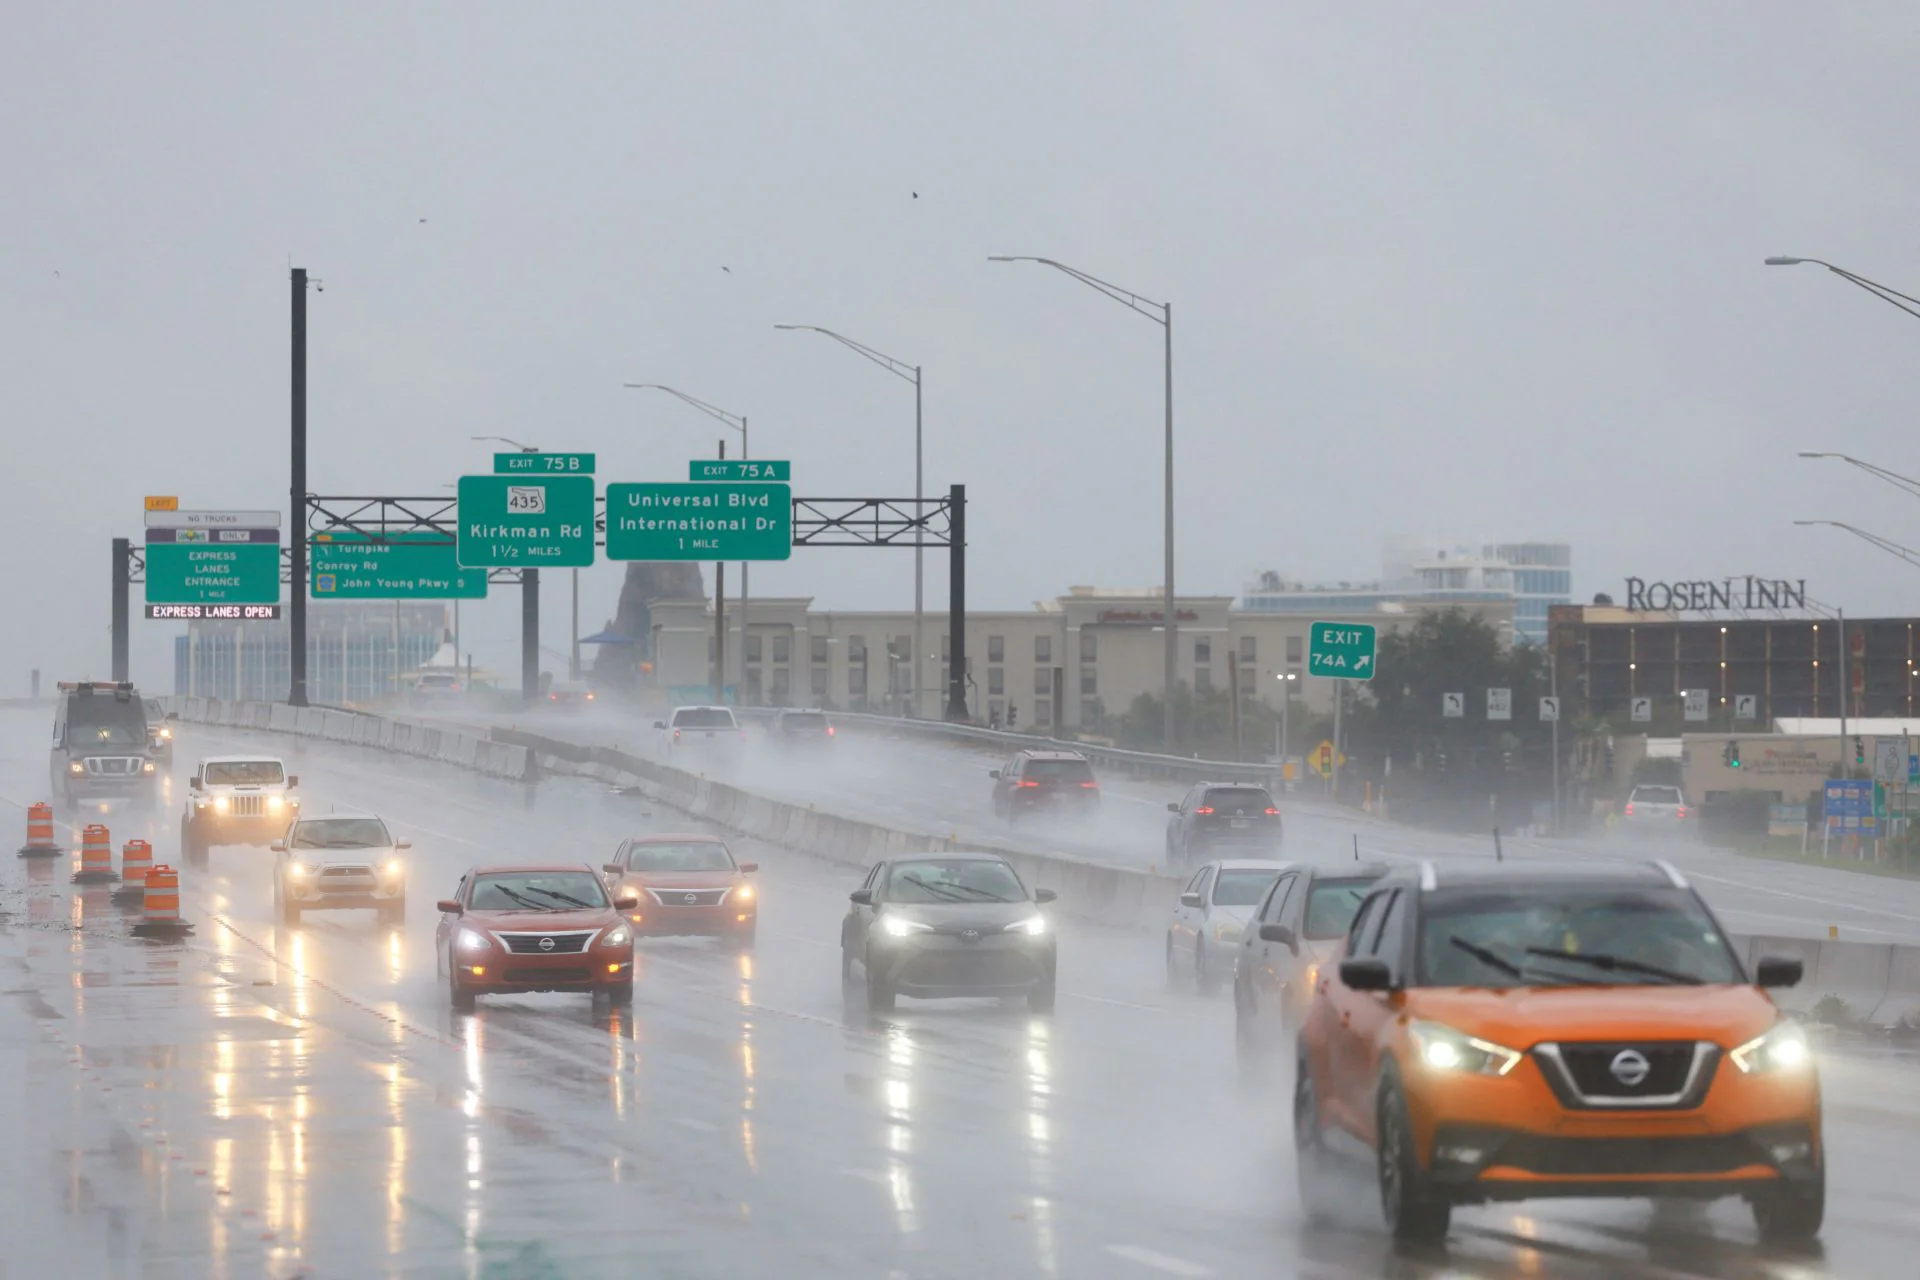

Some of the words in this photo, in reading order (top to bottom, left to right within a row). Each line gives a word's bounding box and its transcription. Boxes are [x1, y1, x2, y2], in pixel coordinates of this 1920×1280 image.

[509, 459, 534, 468] EXIT
[544, 457, 565, 470] 75
[569, 457, 580, 470] B
[703, 466, 728, 475] EXIT
[738, 464, 759, 477] 75
[763, 465, 776, 477] A
[510, 496, 538, 509] 435
[628, 493, 719, 507] Universal
[728, 493, 769, 507] Blvd
[188, 515, 200, 523] NO
[204, 515, 238, 523] TRUCKS
[620, 517, 747, 531] International
[755, 517, 777, 531] Dr
[222, 531, 247, 540] ONLY
[470, 524, 550, 538] Kirkman
[560, 523, 583, 538] Rd
[338, 544, 391, 555] Turnpike
[678, 538, 684, 550] 1
[692, 540, 719, 549] MILE
[188, 552, 237, 561] EXPRESS
[528, 547, 562, 556] MILES
[195, 564, 230, 573] LANES
[316, 561, 358, 573] Conroy
[364, 560, 378, 570] Rd
[185, 577, 241, 586] ENTRANCE
[342, 578, 371, 588] John
[377, 578, 414, 590] Young
[418, 578, 450, 590] Pkwy
[1625, 576, 1732, 612] ROSEN
[1743, 574, 1806, 610] INN
[153, 606, 201, 618] EXPRESS
[205, 606, 240, 618] LANES
[245, 606, 273, 618] OPEN
[1323, 630, 1363, 645] EXIT
[1311, 653, 1347, 667] 74A
